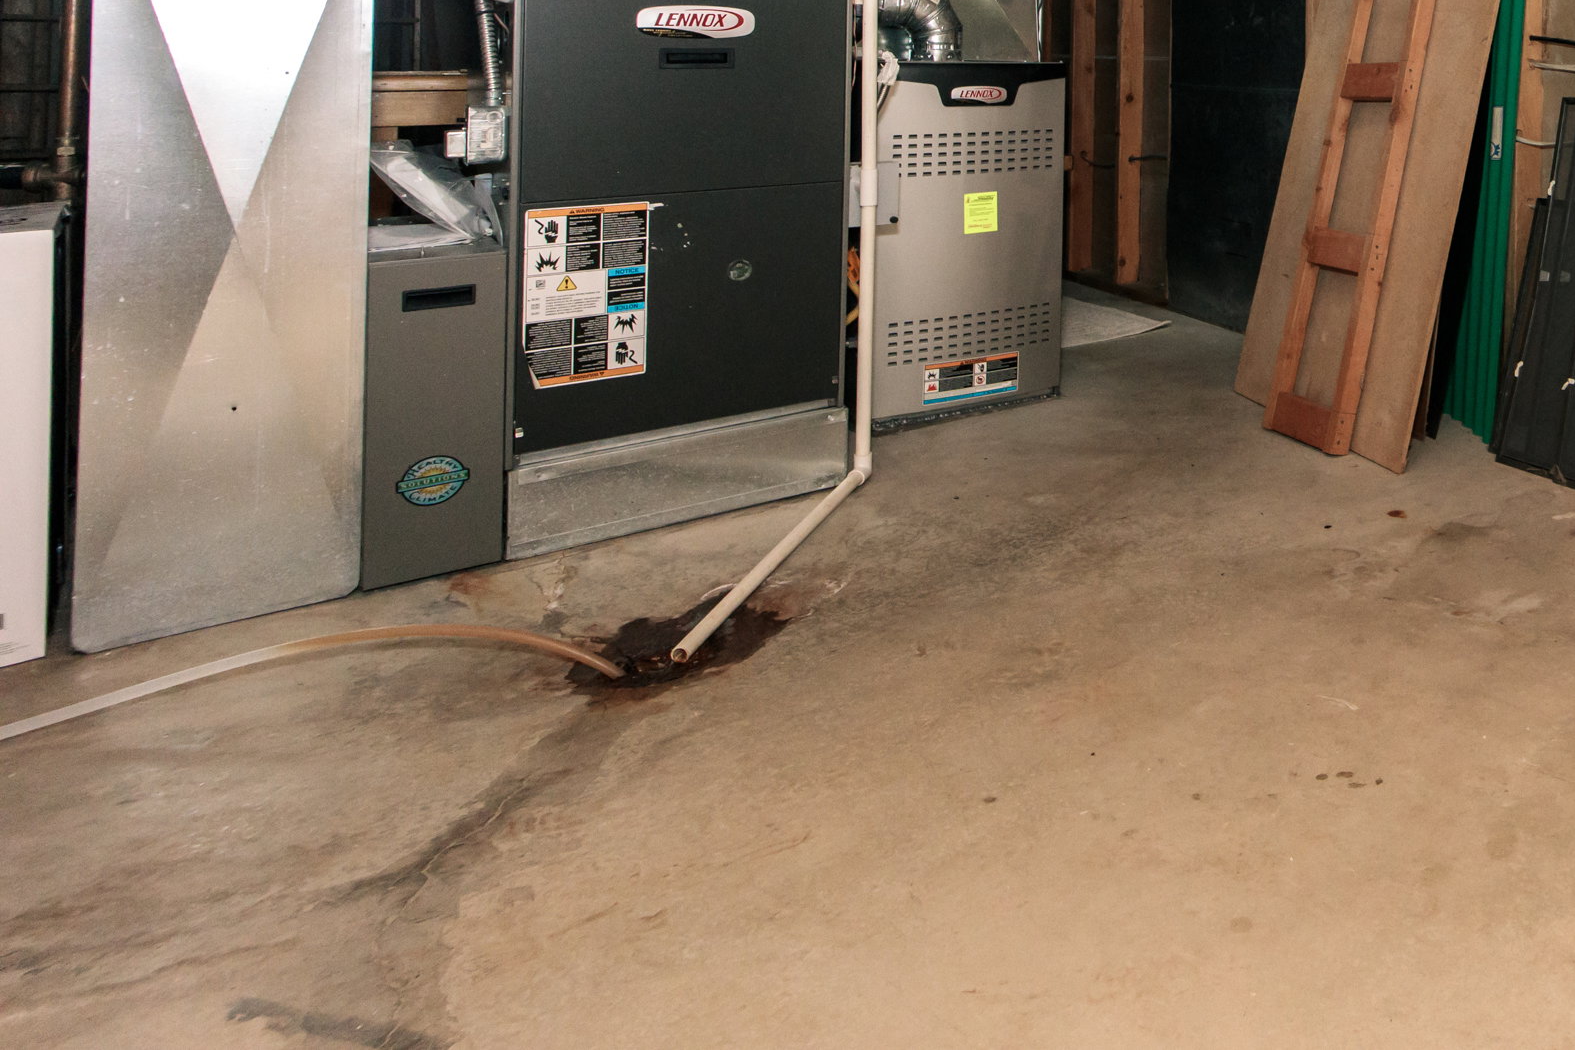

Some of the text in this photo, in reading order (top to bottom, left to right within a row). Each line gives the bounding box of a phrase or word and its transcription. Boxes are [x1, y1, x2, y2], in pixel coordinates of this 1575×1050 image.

[654, 12, 727, 27] LENNOX
[960, 90, 994, 98] LENNOX
[615, 267, 640, 275] NOTICE
[406, 459, 460, 478] HEALTHY
[400, 472, 466, 489] SOLUTIONS
[409, 485, 457, 502] CLIMATE
